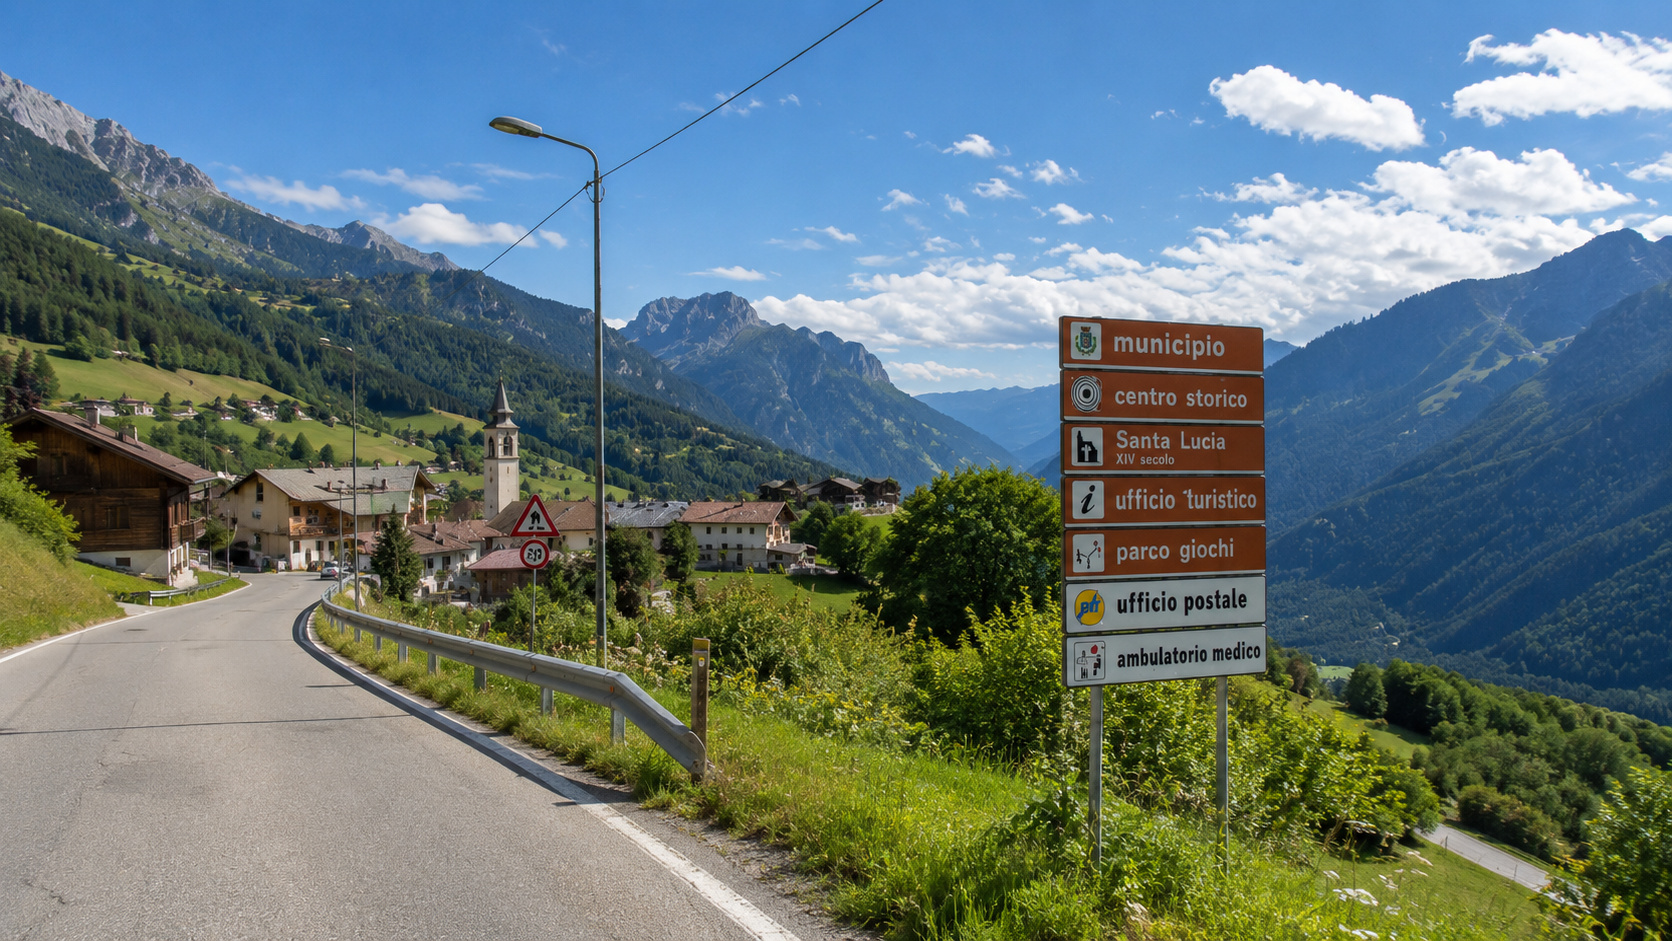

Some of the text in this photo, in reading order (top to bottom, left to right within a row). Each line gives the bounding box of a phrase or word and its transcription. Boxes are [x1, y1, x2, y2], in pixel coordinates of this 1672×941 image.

[1114, 333, 1224, 360] municipio
[1115, 388, 1247, 407] centro storico
[1117, 430, 1225, 449] Santa Lucia
[1116, 453, 1174, 464] XIV secolo
[1116, 488, 1256, 510] ufficio turistico
[1117, 538, 1233, 564] parco giochi
[1118, 591, 1177, 614] ufficio
[1185, 588, 1247, 616] postale
[1118, 642, 1260, 667] ambulatorio medico
